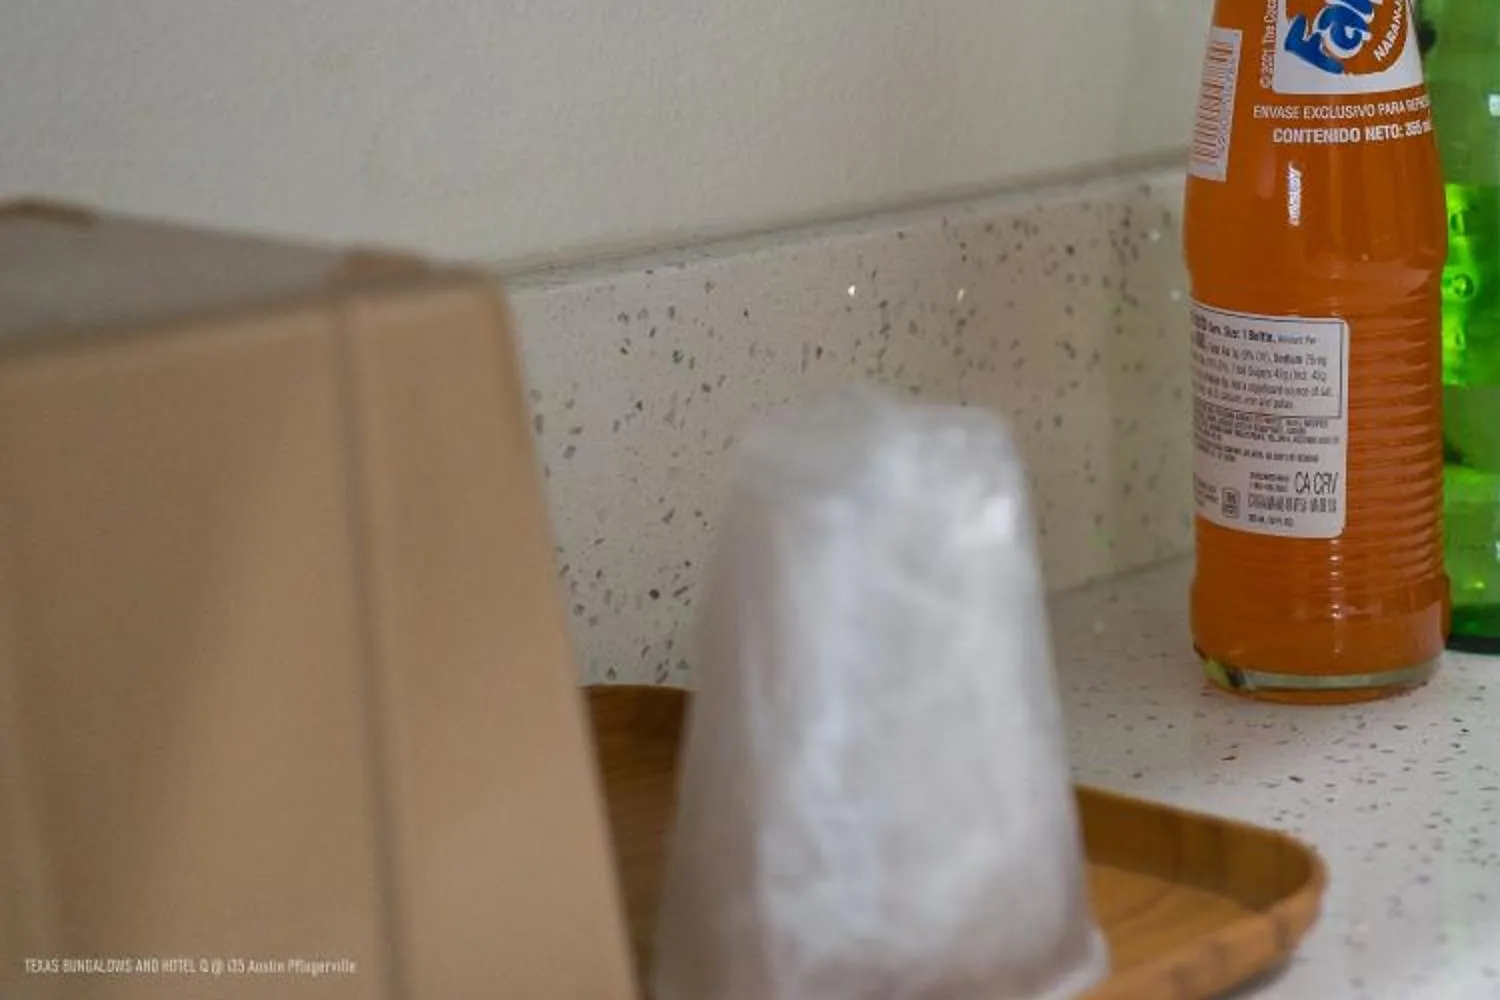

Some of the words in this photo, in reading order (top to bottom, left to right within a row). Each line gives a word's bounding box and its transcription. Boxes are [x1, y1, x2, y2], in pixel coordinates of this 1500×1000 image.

[1262, 26, 1275, 44] The
[1253, 104, 1300, 119] ENVASE
[1304, 103, 1375, 119] EXCLUSIVO
[1378, 100, 1405, 117] PARA
[1273, 126, 1361, 143] CONTENIDO
[1365, 123, 1404, 141] NETO:
[1295, 471, 1310, 494] CA
[1313, 471, 1339, 495] CRV
